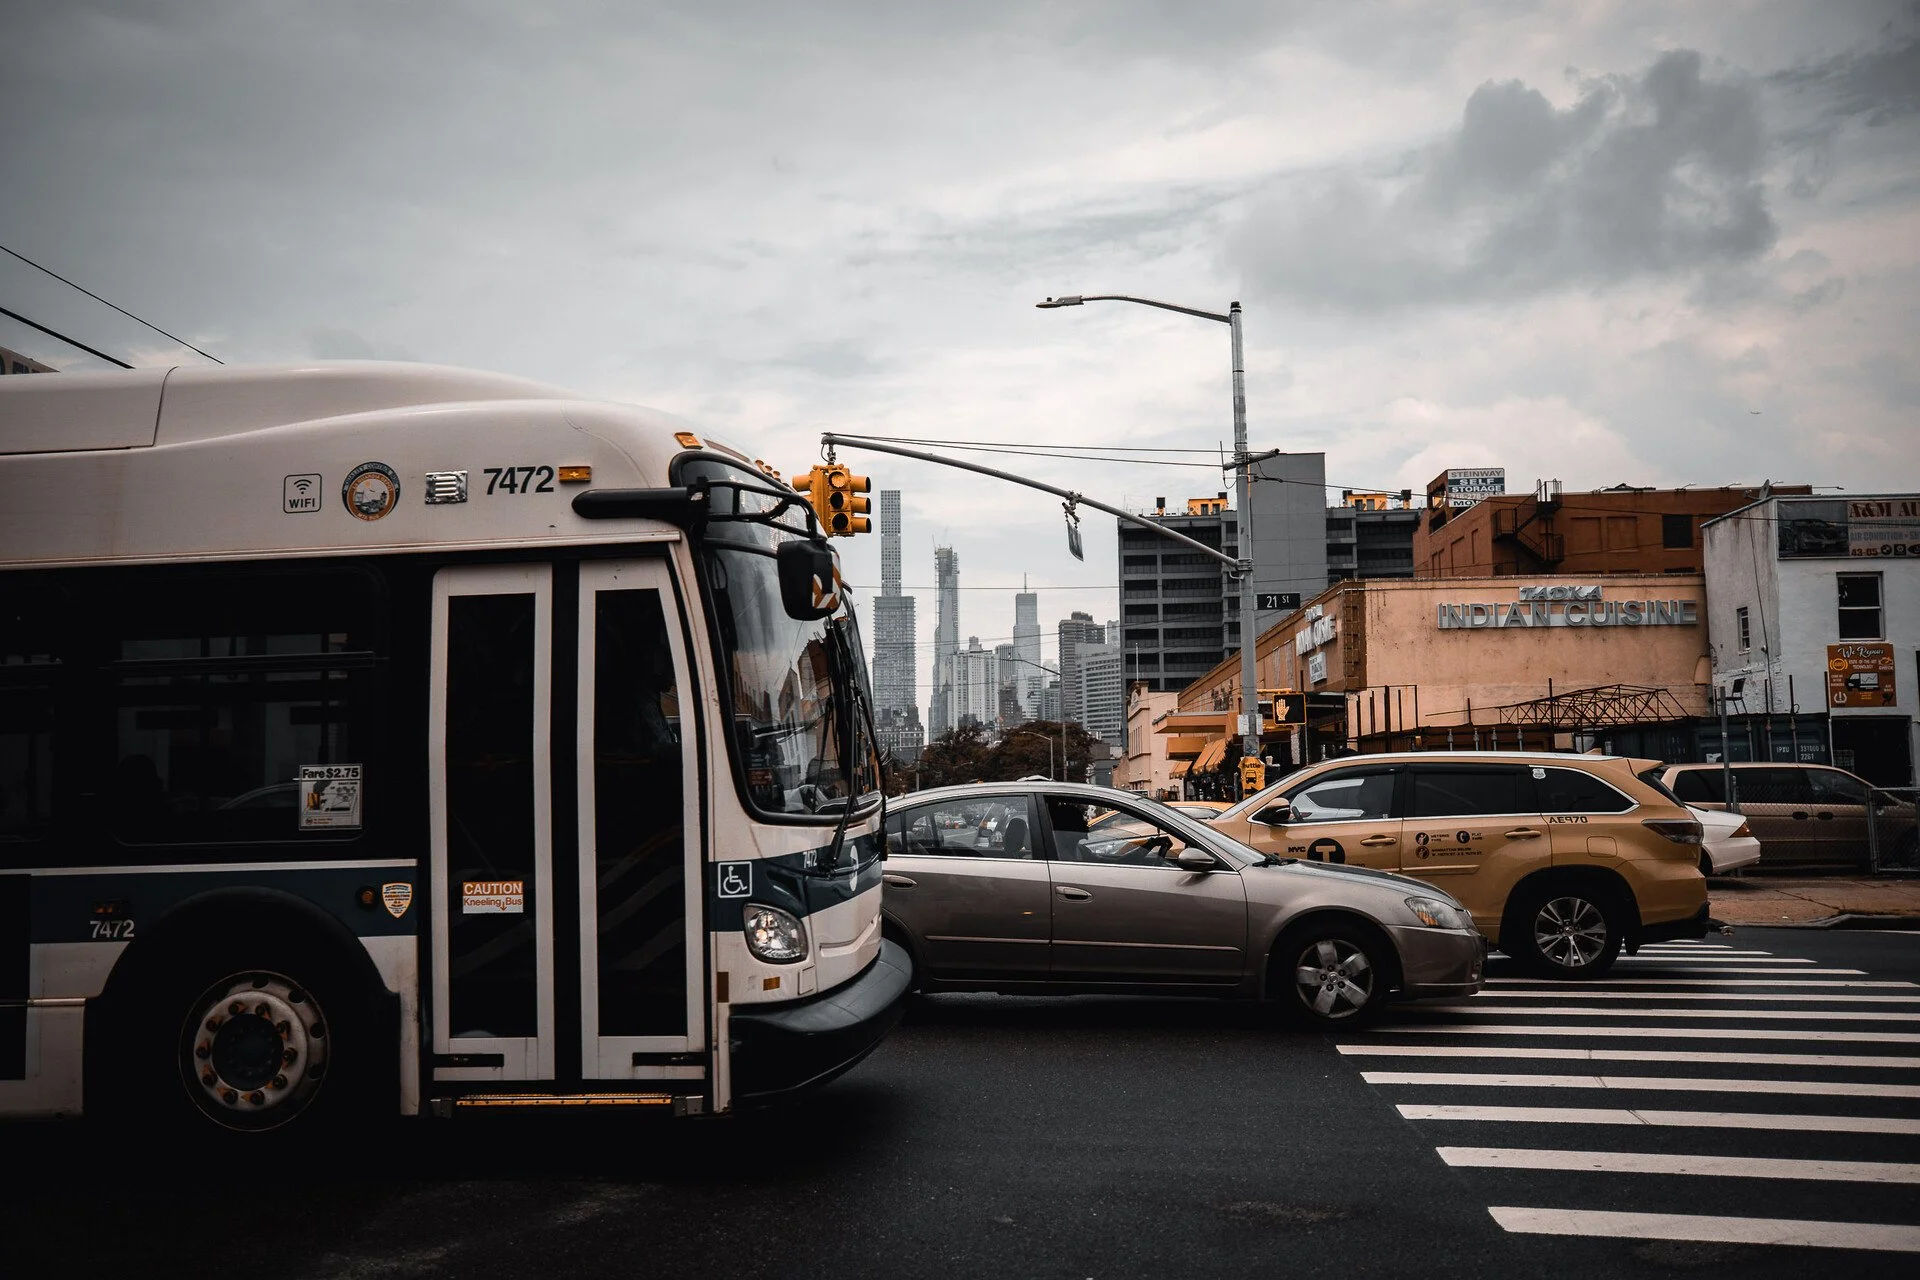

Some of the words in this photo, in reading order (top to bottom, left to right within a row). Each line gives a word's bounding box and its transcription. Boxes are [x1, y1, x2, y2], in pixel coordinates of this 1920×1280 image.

[483, 465, 554, 495] 7472
[1451, 470, 1502, 478] STEINWAY
[1451, 485, 1502, 493] STORAGE
[289, 498, 315, 508] WIFI
[1849, 502, 1892, 518] A&M
[1899, 502, 1920, 517] AU
[1520, 586, 1602, 600] TADKA
[1266, 595, 1278, 608] 21
[1282, 595, 1290, 604] St
[1438, 602, 1551, 628] INDIAN
[1564, 600, 1698, 627] CUISINE
[1837, 645, 1855, 658] We
[1857, 645, 1885, 658] Repair
[302, 769, 325, 779] Fare
[326, 767, 359, 779] $2.75
[1549, 816, 1588, 824] AE970
[464, 883, 522, 895] CAUTION
[464, 897, 501, 909] Kneeling
[505, 897, 522, 906] Bus
[89, 919, 135, 939] 7472
